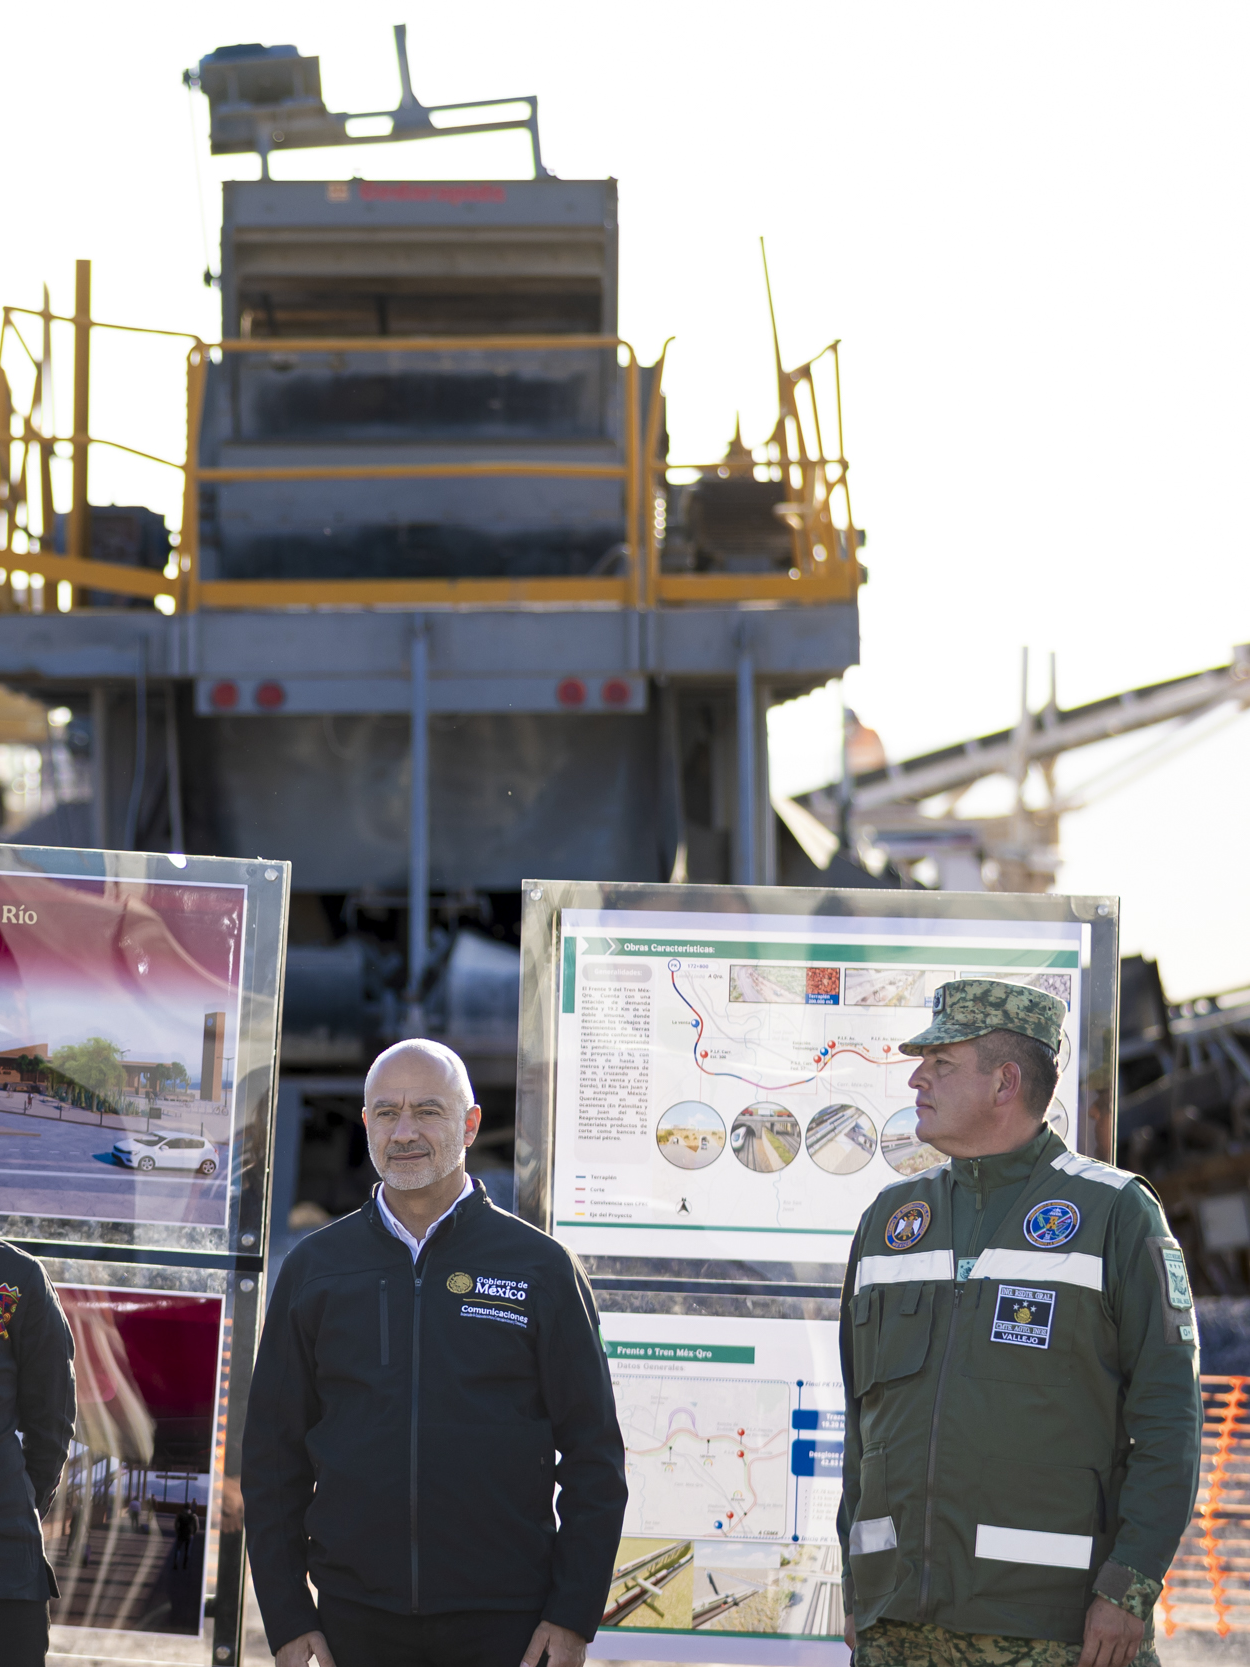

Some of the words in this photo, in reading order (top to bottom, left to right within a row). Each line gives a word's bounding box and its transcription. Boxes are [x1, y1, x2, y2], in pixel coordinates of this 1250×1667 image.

[1, 904, 37, 925] Río
[624, 943, 649, 951] Obras
[651, 943, 715, 954] Características:
[476, 1276, 516, 1287] Gobierno
[517, 1281, 528, 1289] de
[475, 1282, 526, 1300] México
[461, 1305, 528, 1323] Comunicaciones
[1002, 1333, 1038, 1344] VALLEJO
[617, 1346, 645, 1356] Frente
[655, 1347, 674, 1357] Tren
[676, 1348, 712, 1359] Méx-Qro
[617, 1361, 641, 1370] Datos
